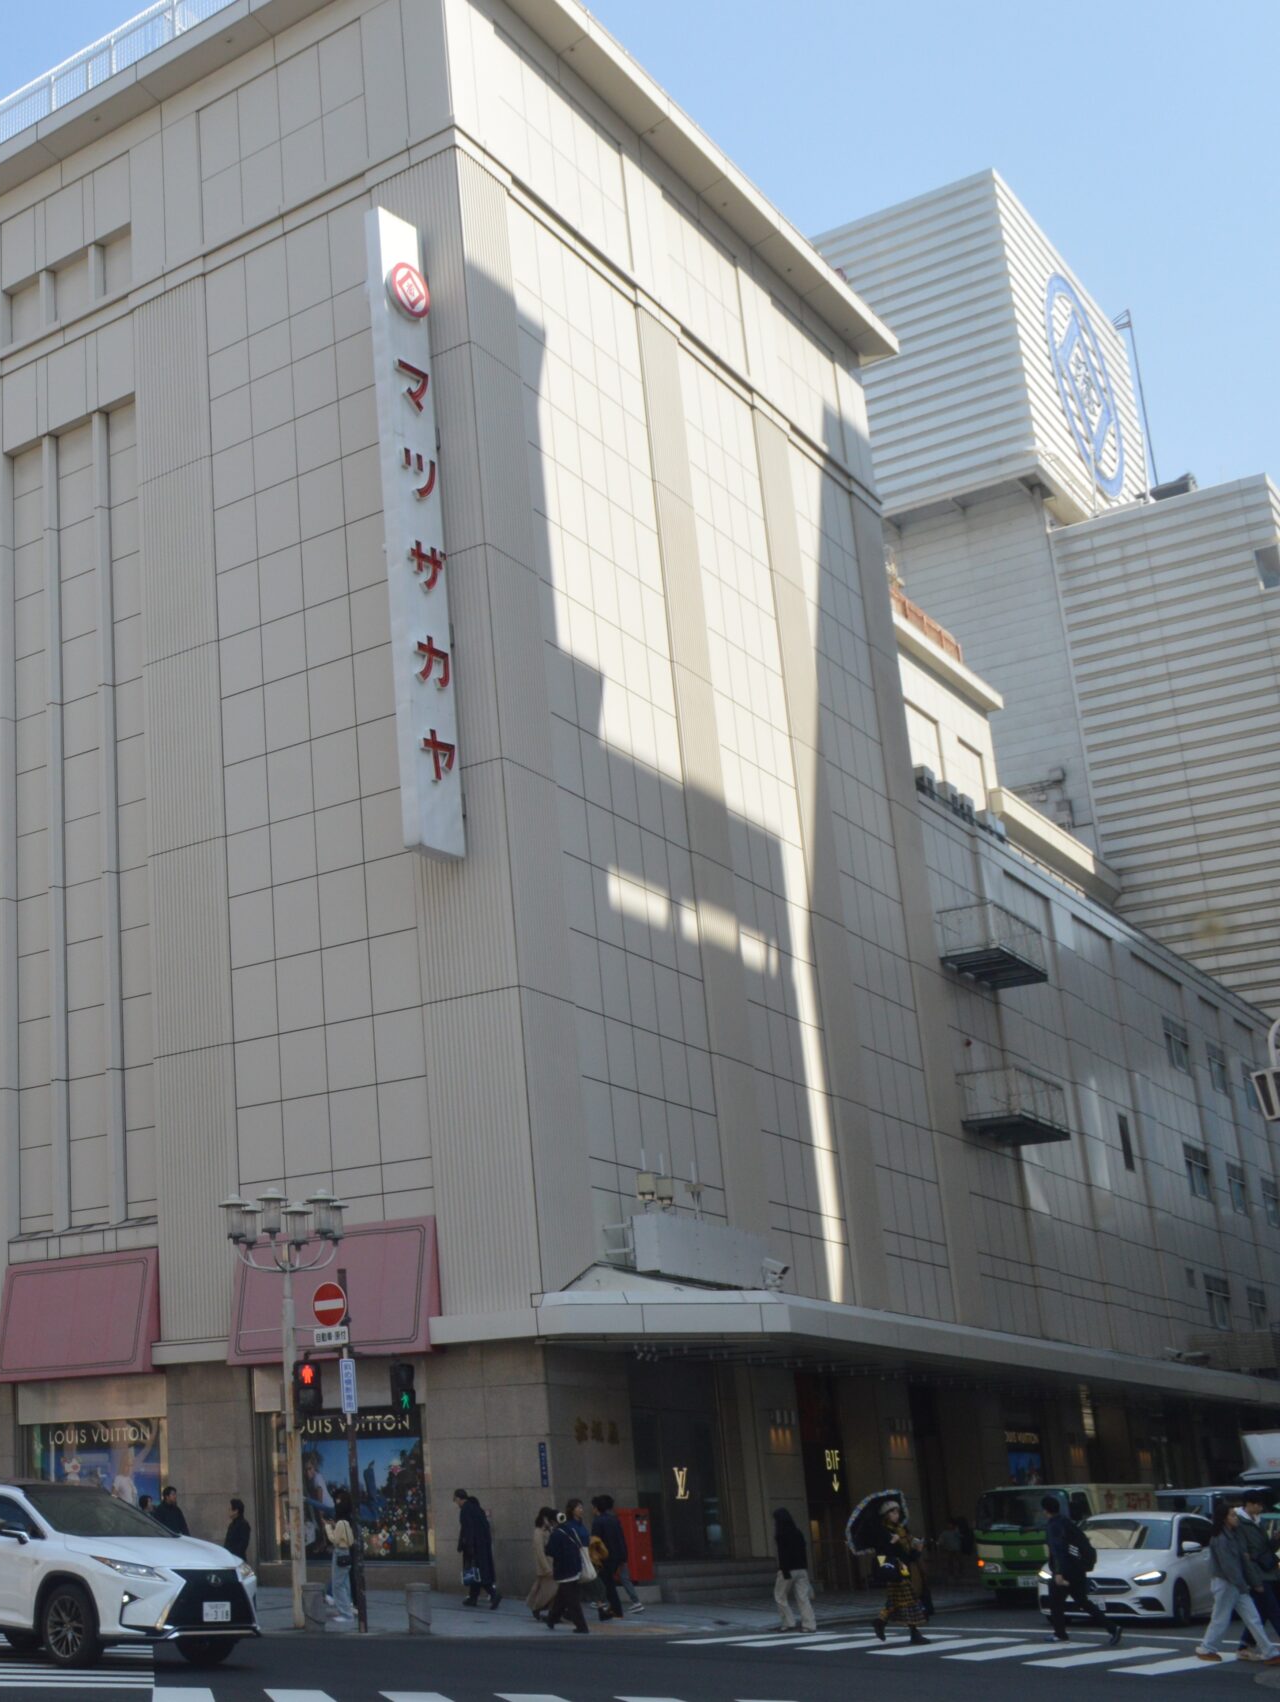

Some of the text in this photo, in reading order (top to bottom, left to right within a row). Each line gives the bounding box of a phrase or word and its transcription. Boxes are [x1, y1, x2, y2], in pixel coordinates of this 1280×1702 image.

[394, 358, 456, 782] マツザカヤ
[49, 1422, 151, 1445] LOUIS VUITTON
[825, 1449, 841, 1471] B1F
